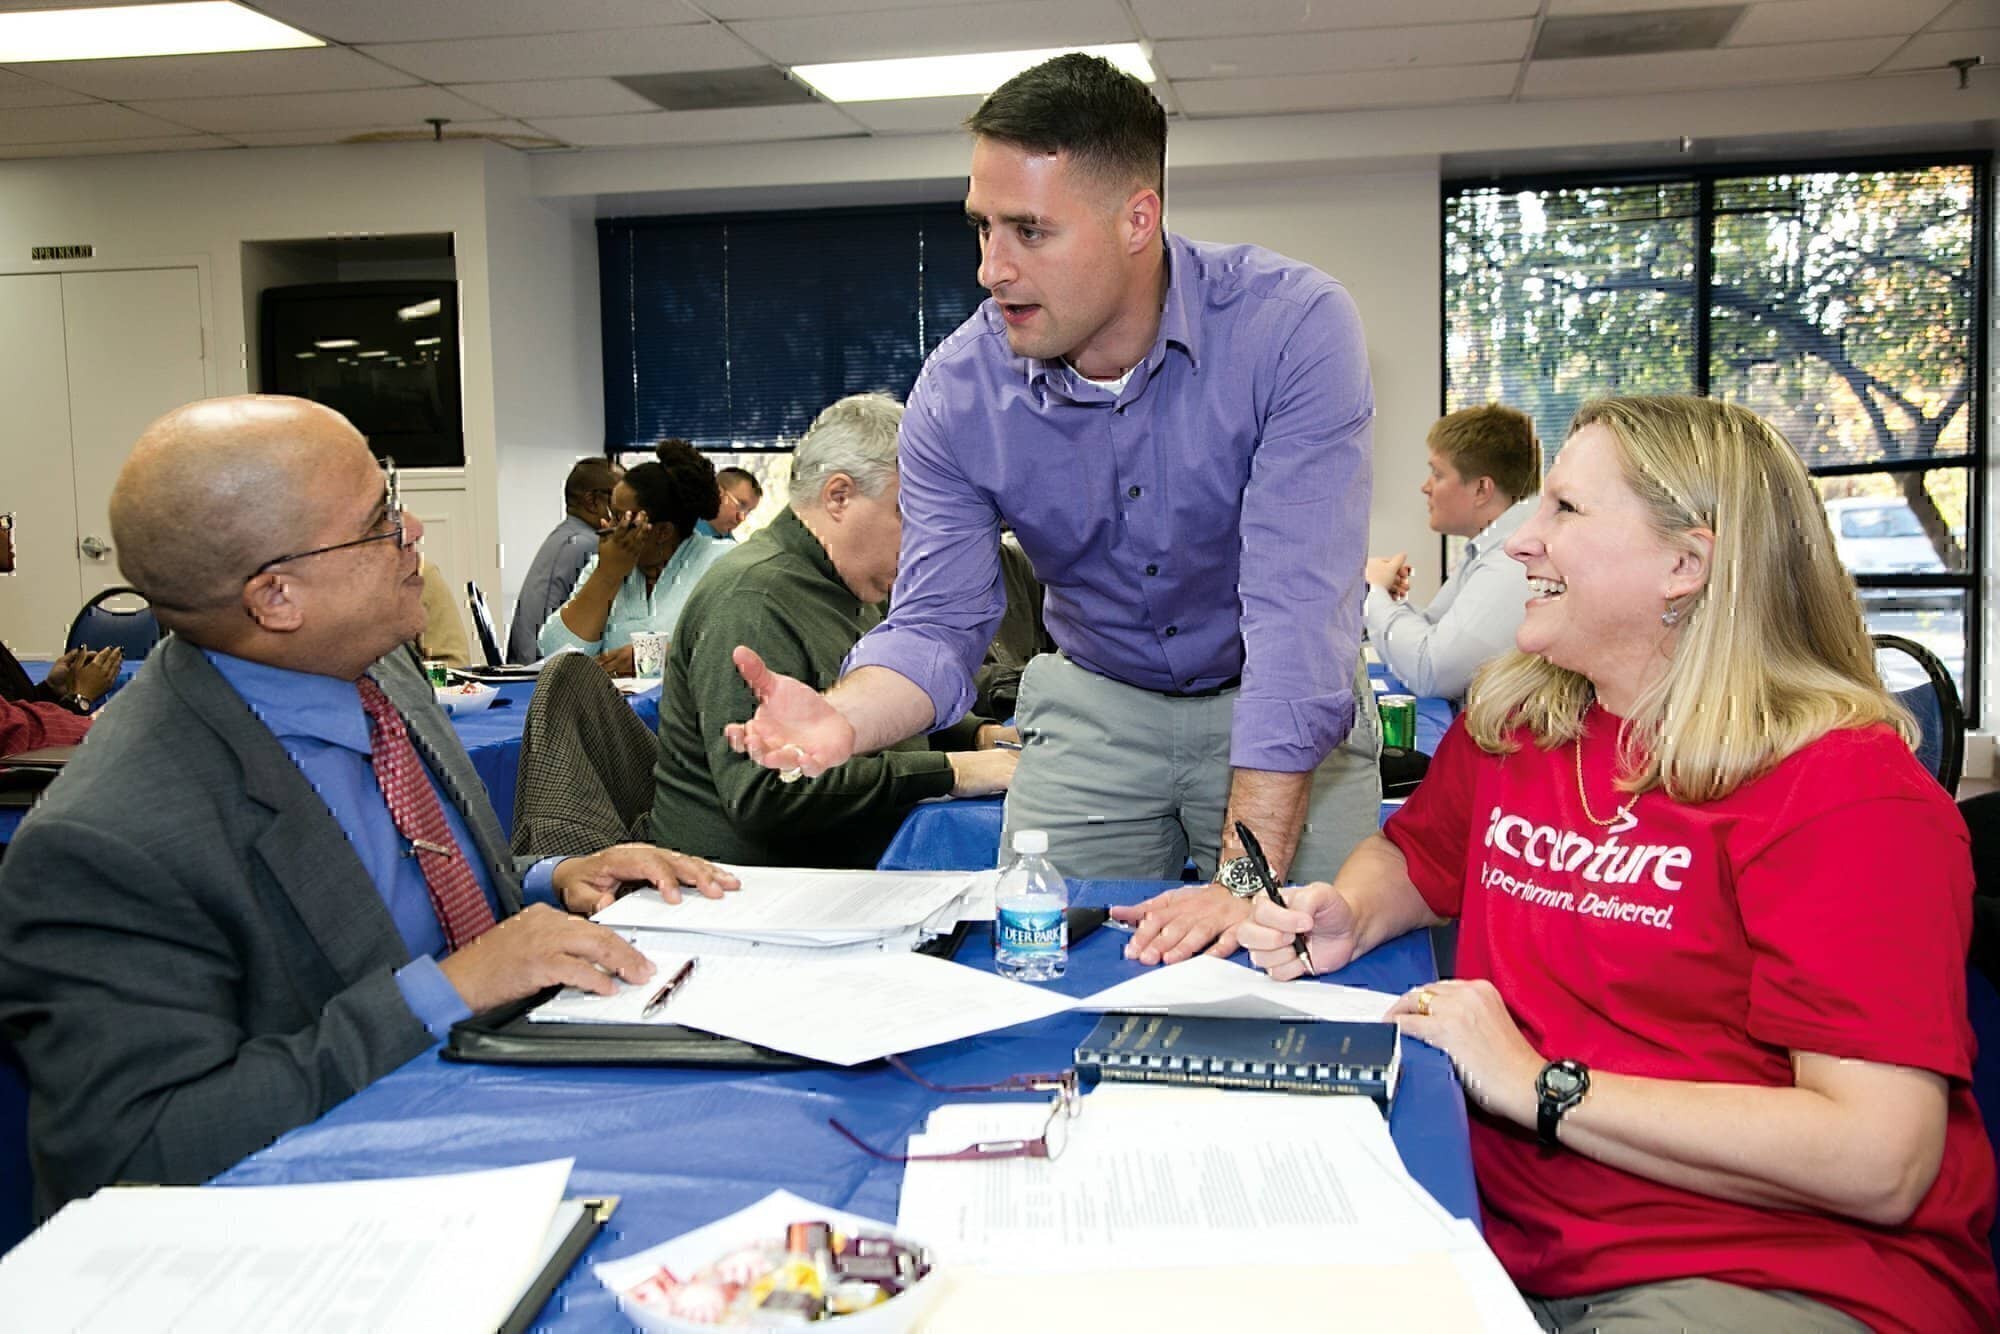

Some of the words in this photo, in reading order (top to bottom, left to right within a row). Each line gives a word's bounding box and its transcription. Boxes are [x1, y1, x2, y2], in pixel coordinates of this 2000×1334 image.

[1577, 892, 1674, 930] Delivered.
[1005, 926, 1032, 944] DEER
[1034, 928, 1060, 944] PARK
